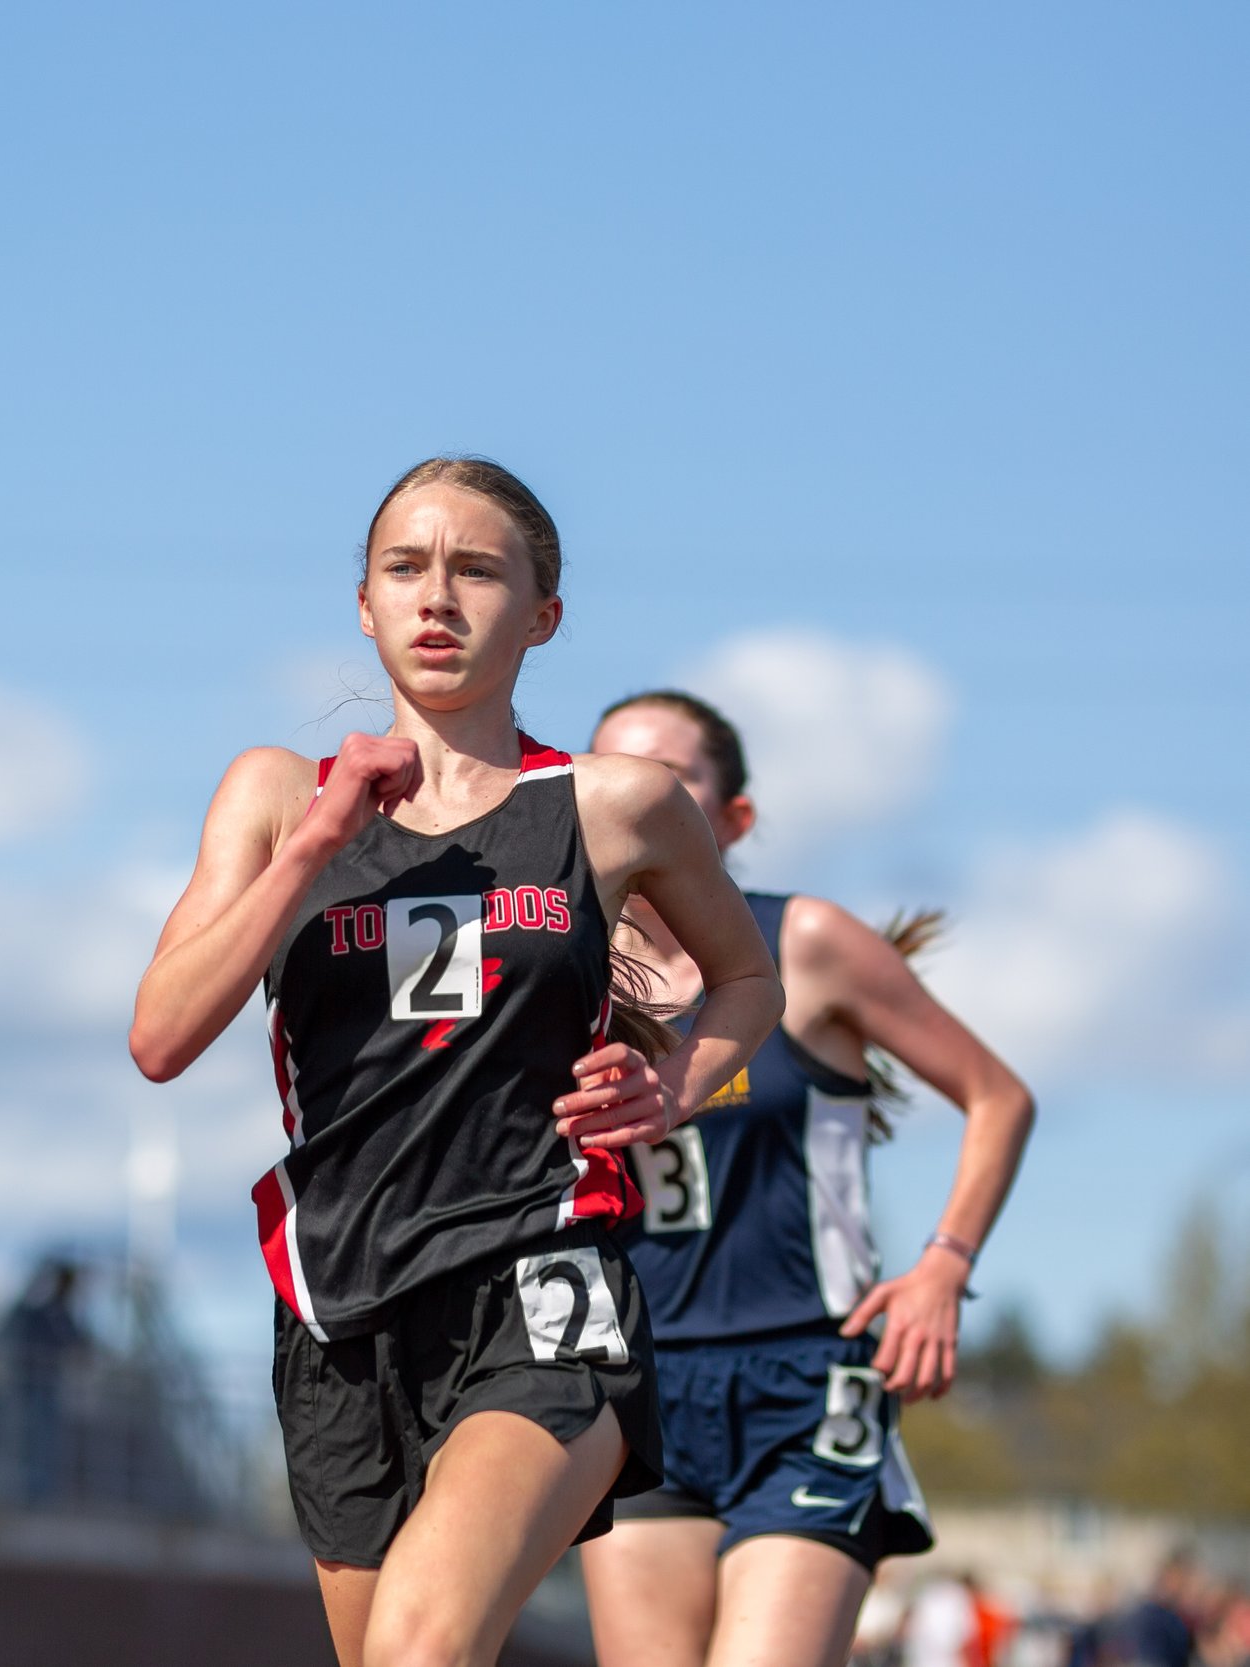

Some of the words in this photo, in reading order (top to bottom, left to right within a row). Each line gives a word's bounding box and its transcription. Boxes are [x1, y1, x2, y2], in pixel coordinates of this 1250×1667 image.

[324, 885, 571, 955] TODOS
[408, 903, 463, 1012] 2
[650, 1138, 689, 1223] 3
[537, 1260, 610, 1361] 2
[833, 1374, 868, 1455] 3
